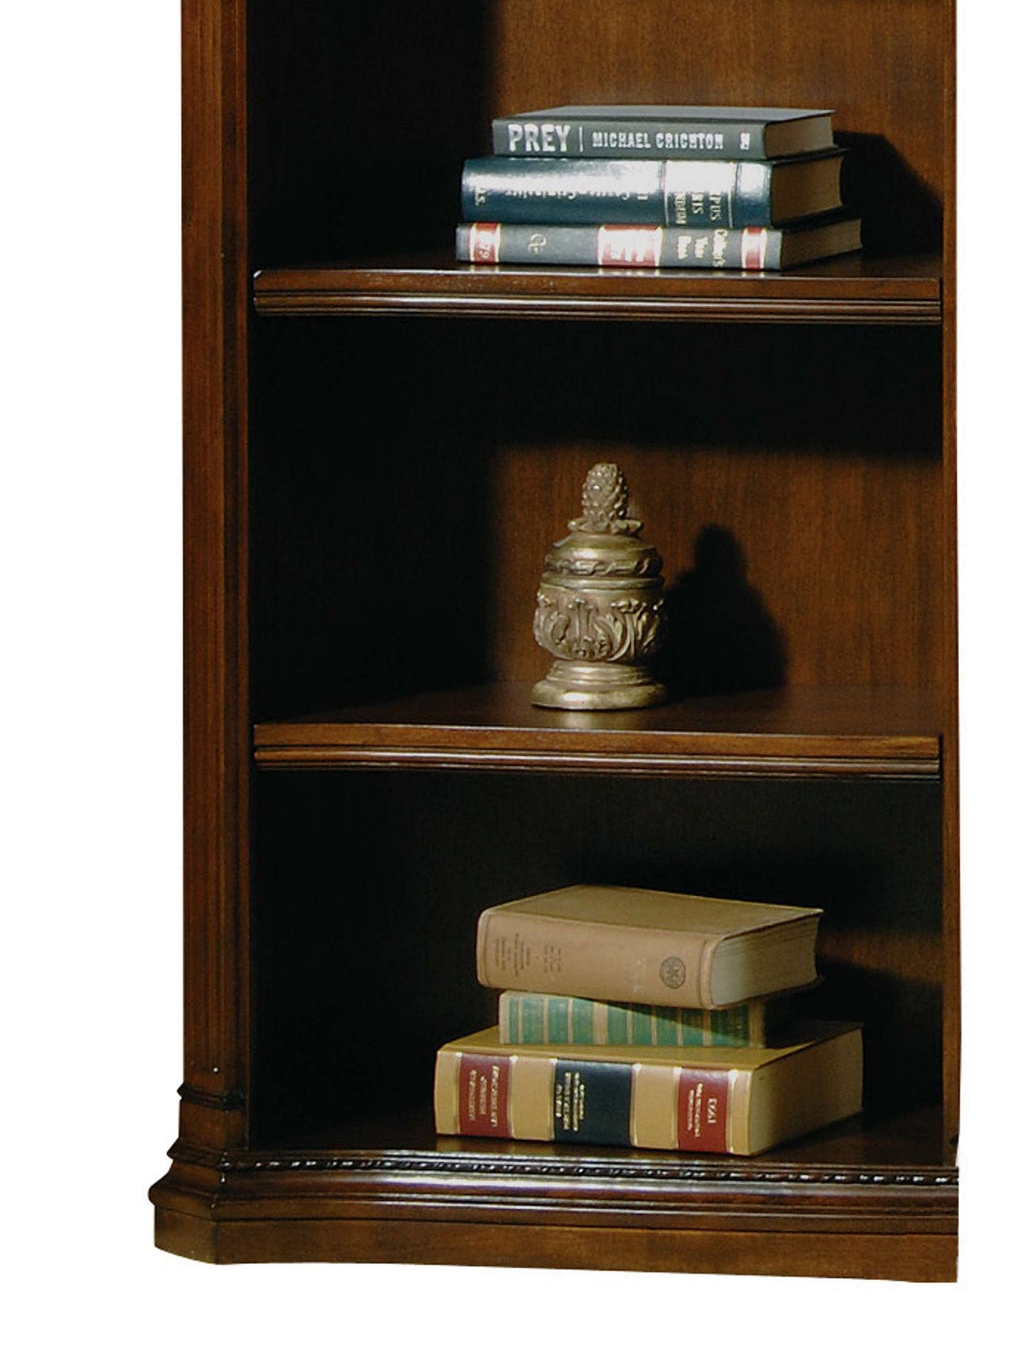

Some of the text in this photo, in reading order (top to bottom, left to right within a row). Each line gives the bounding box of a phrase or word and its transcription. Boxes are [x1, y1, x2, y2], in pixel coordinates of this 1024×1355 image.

[507, 123, 723, 152] PREY MICHAEL CRICHTON
